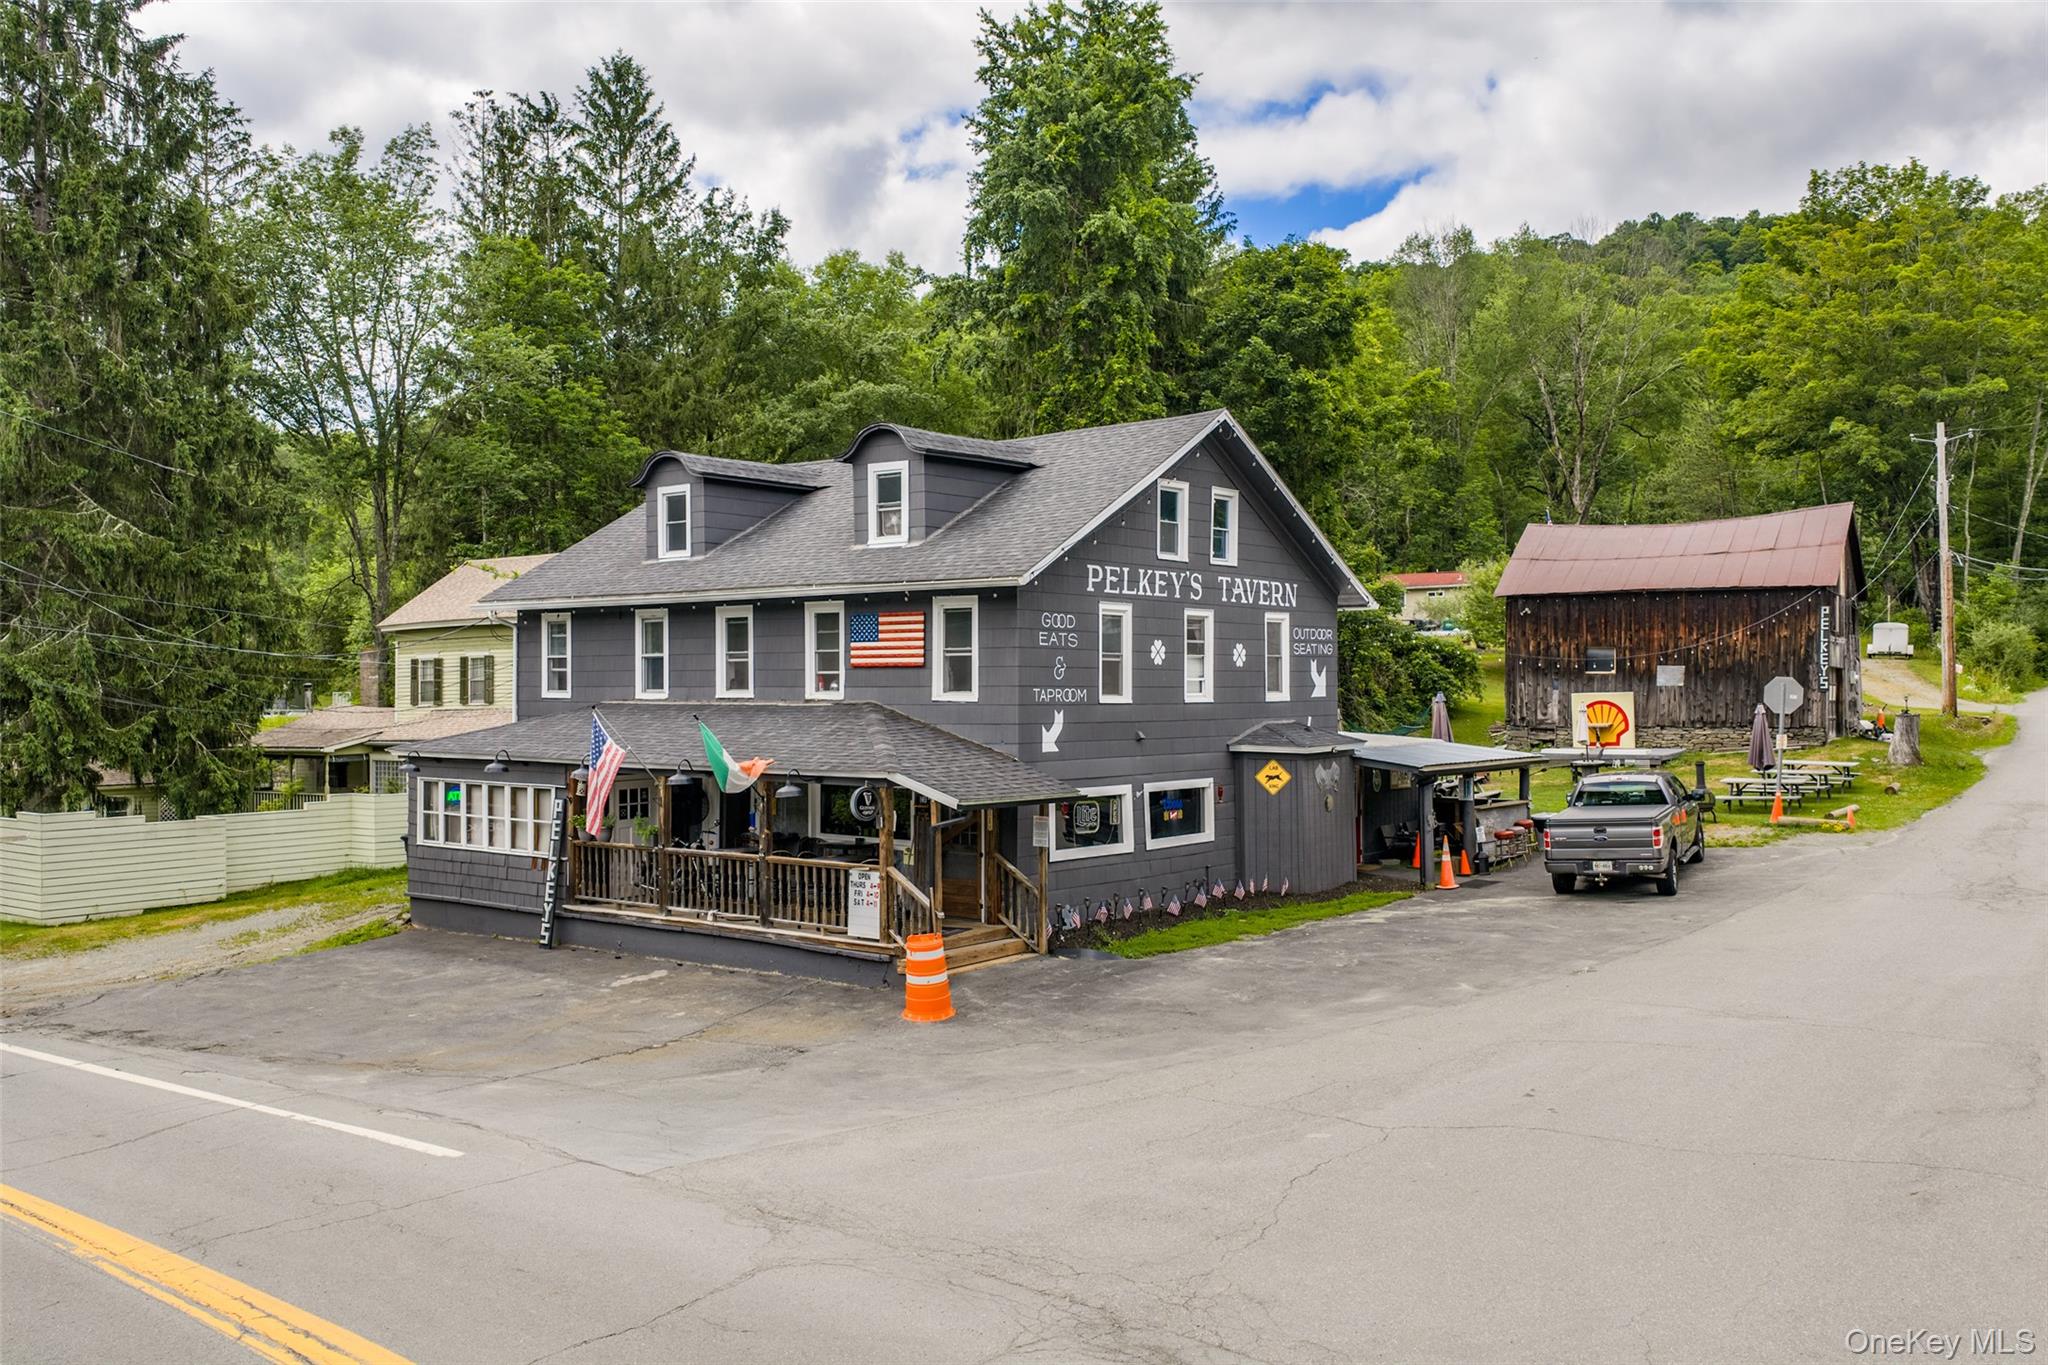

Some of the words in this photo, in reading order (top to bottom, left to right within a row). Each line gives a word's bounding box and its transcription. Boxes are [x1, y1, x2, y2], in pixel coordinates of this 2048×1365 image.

[1086, 564, 1203, 601] PELKEY'S
[1218, 576, 1298, 608] TAVERN
[1041, 612, 1076, 629] GOOD
[1039, 631, 1079, 648] EATS
[1292, 627, 1333, 640] OUTDOOR
[1293, 643, 1334, 655] SEATING
[1053, 655, 1067, 680] &
[1032, 687, 1088, 703] TAPROOM
[857, 872, 871, 881] OPEN
[850, 880, 866, 889] THURS
[854, 889, 864, 898] FRI
[853, 898, 864, 907] SAT
